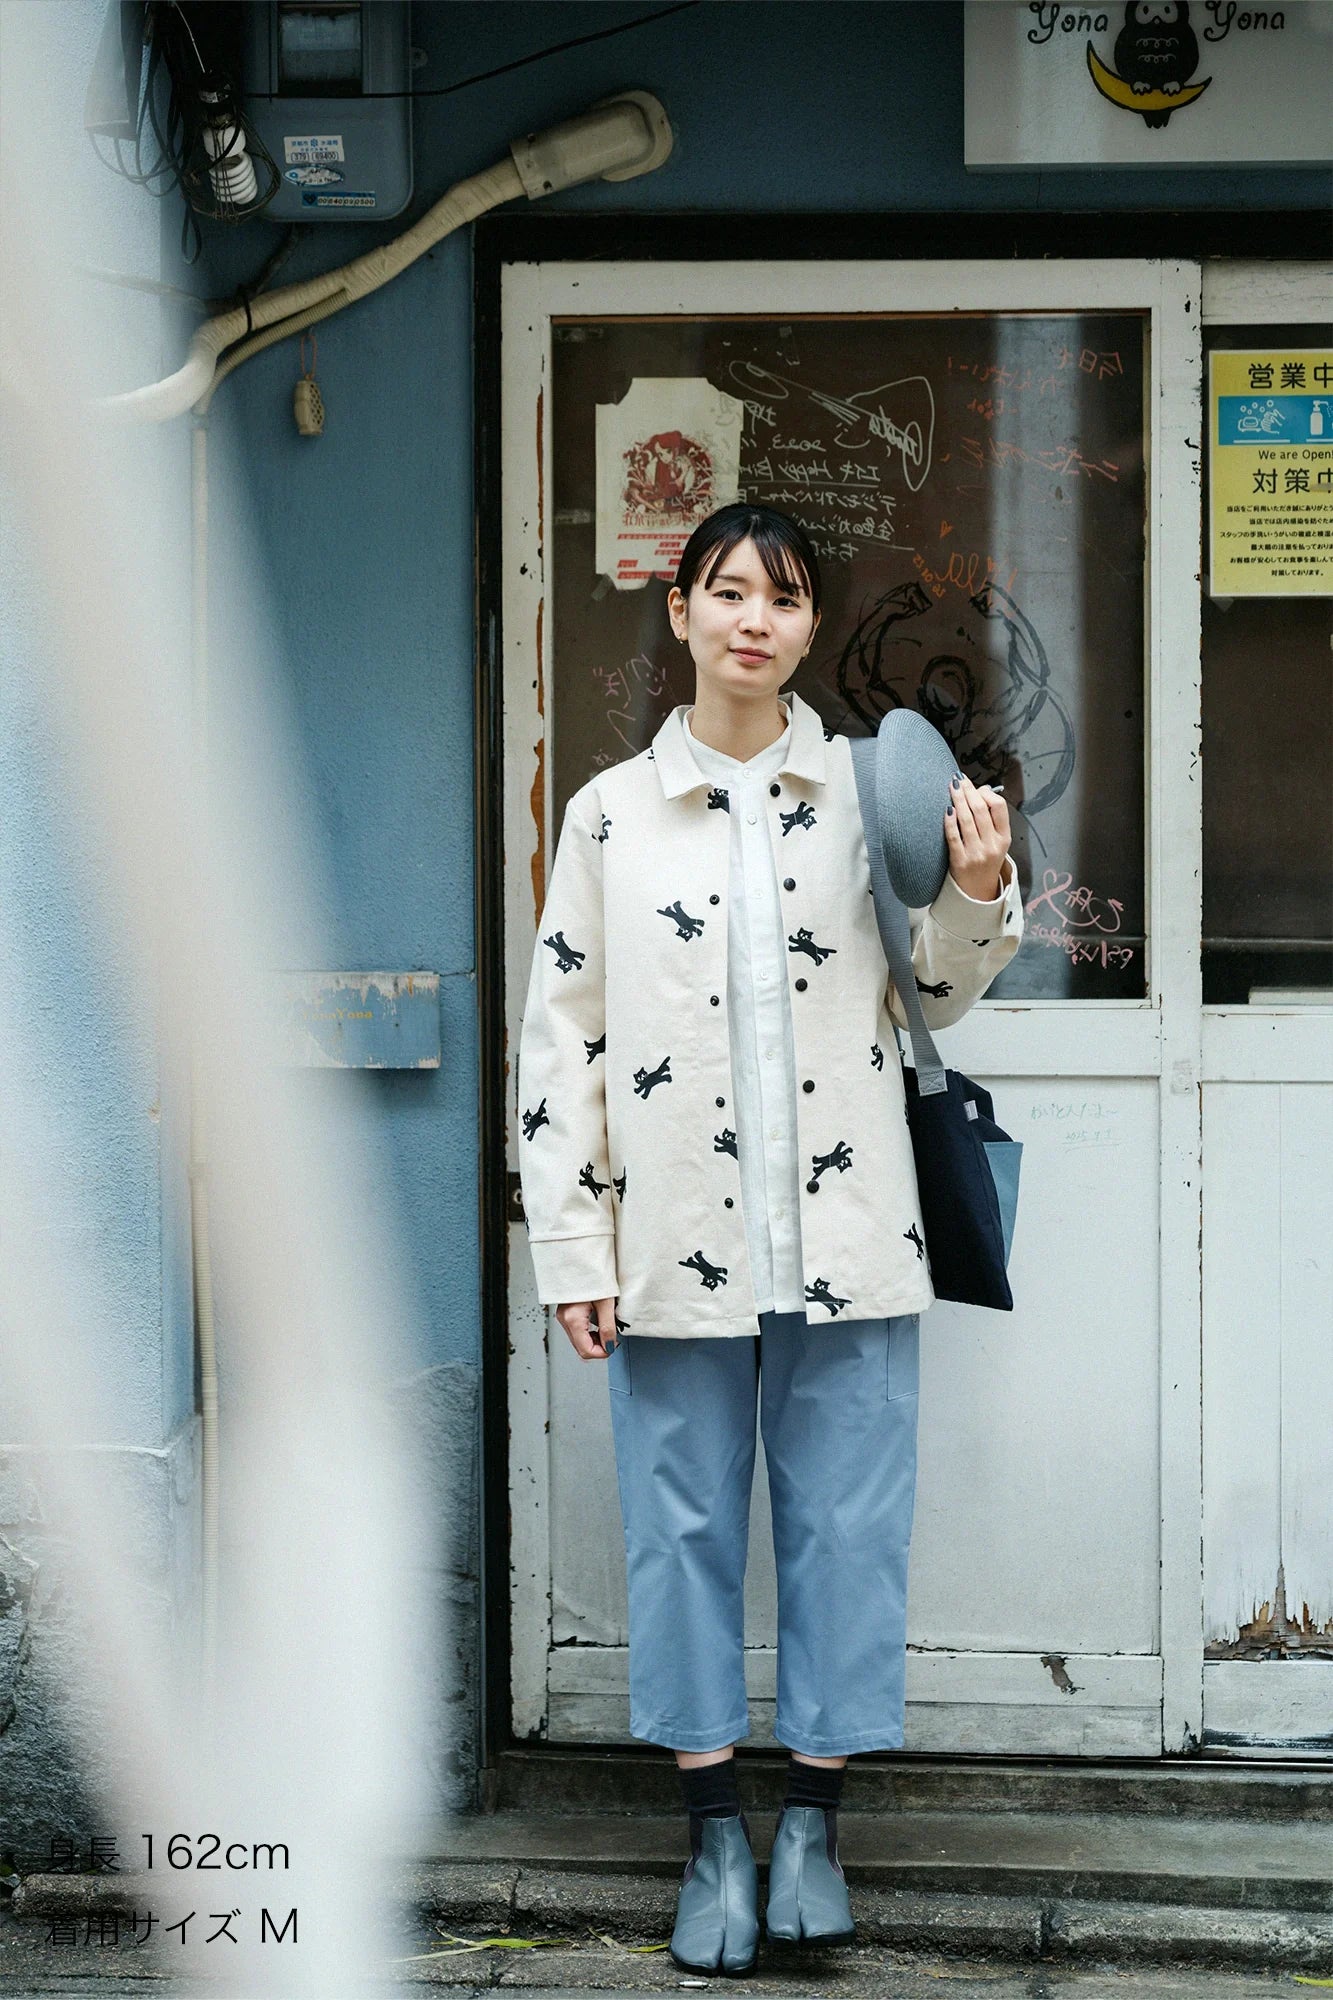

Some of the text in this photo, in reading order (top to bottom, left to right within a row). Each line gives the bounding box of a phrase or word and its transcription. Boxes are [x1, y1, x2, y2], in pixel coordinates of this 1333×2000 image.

[1027, 0, 1285, 44] Yona Yona
[1248, 362, 1333, 389] 営業中
[1258, 450, 1277, 460] We
[1280, 450, 1299, 460] are
[1252, 467, 1333, 494] 対策中
